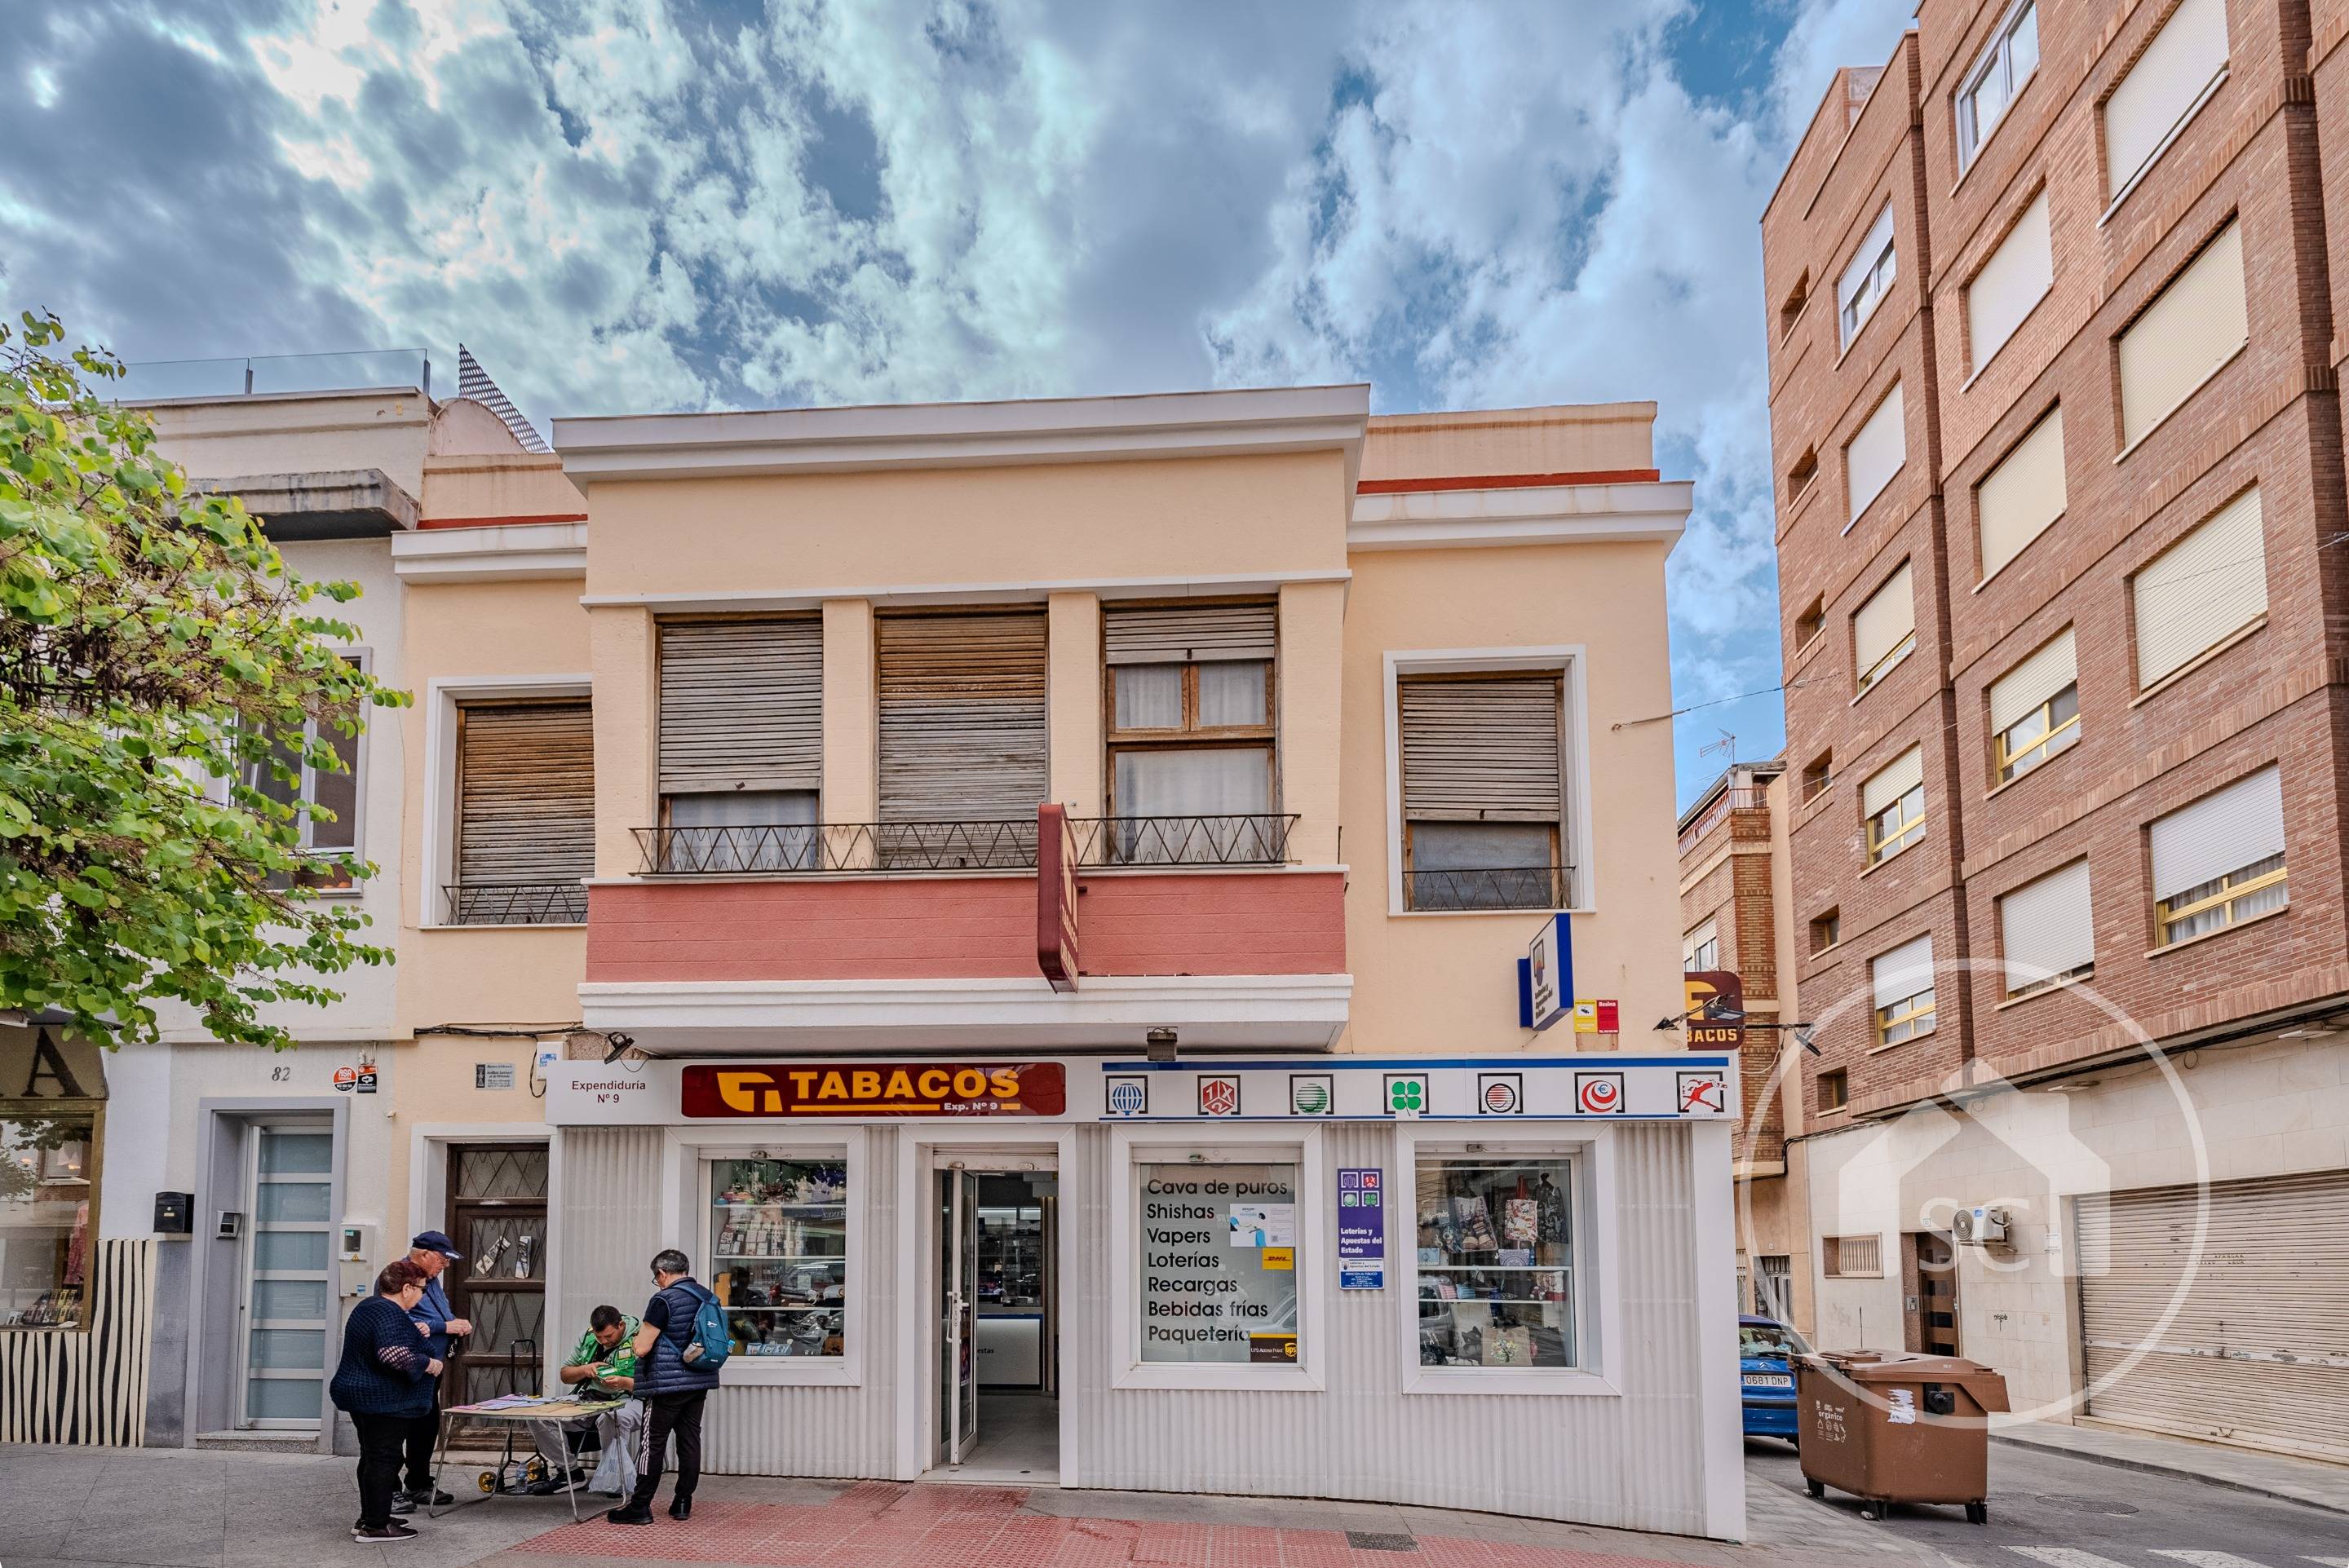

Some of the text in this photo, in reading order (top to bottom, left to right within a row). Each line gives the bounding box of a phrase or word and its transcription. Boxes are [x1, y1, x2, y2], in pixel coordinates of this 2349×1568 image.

[272, 1067, 291, 1081] 82
[572, 1080, 646, 1092] Expendiduría
[790, 1068, 1021, 1099] TABACOS
[597, 1093, 620, 1103] Nº 9
[944, 1102, 998, 1111] Exp. Nº 9
[1147, 1179, 1288, 1198] Cava de puros
[1147, 1203, 1214, 1219] Shishas
[1147, 1228, 1211, 1247] Vapers
[1341, 1237, 1371, 1245] Apuestas
[1148, 1251, 1219, 1268] Loterías
[1148, 1276, 1238, 1296] Recargas
[1148, 1301, 1268, 1317] Bebidas frías
[1745, 1376, 1789, 1385] 0681 DNP
[1818, 1411, 1843, 1421] orgánico
